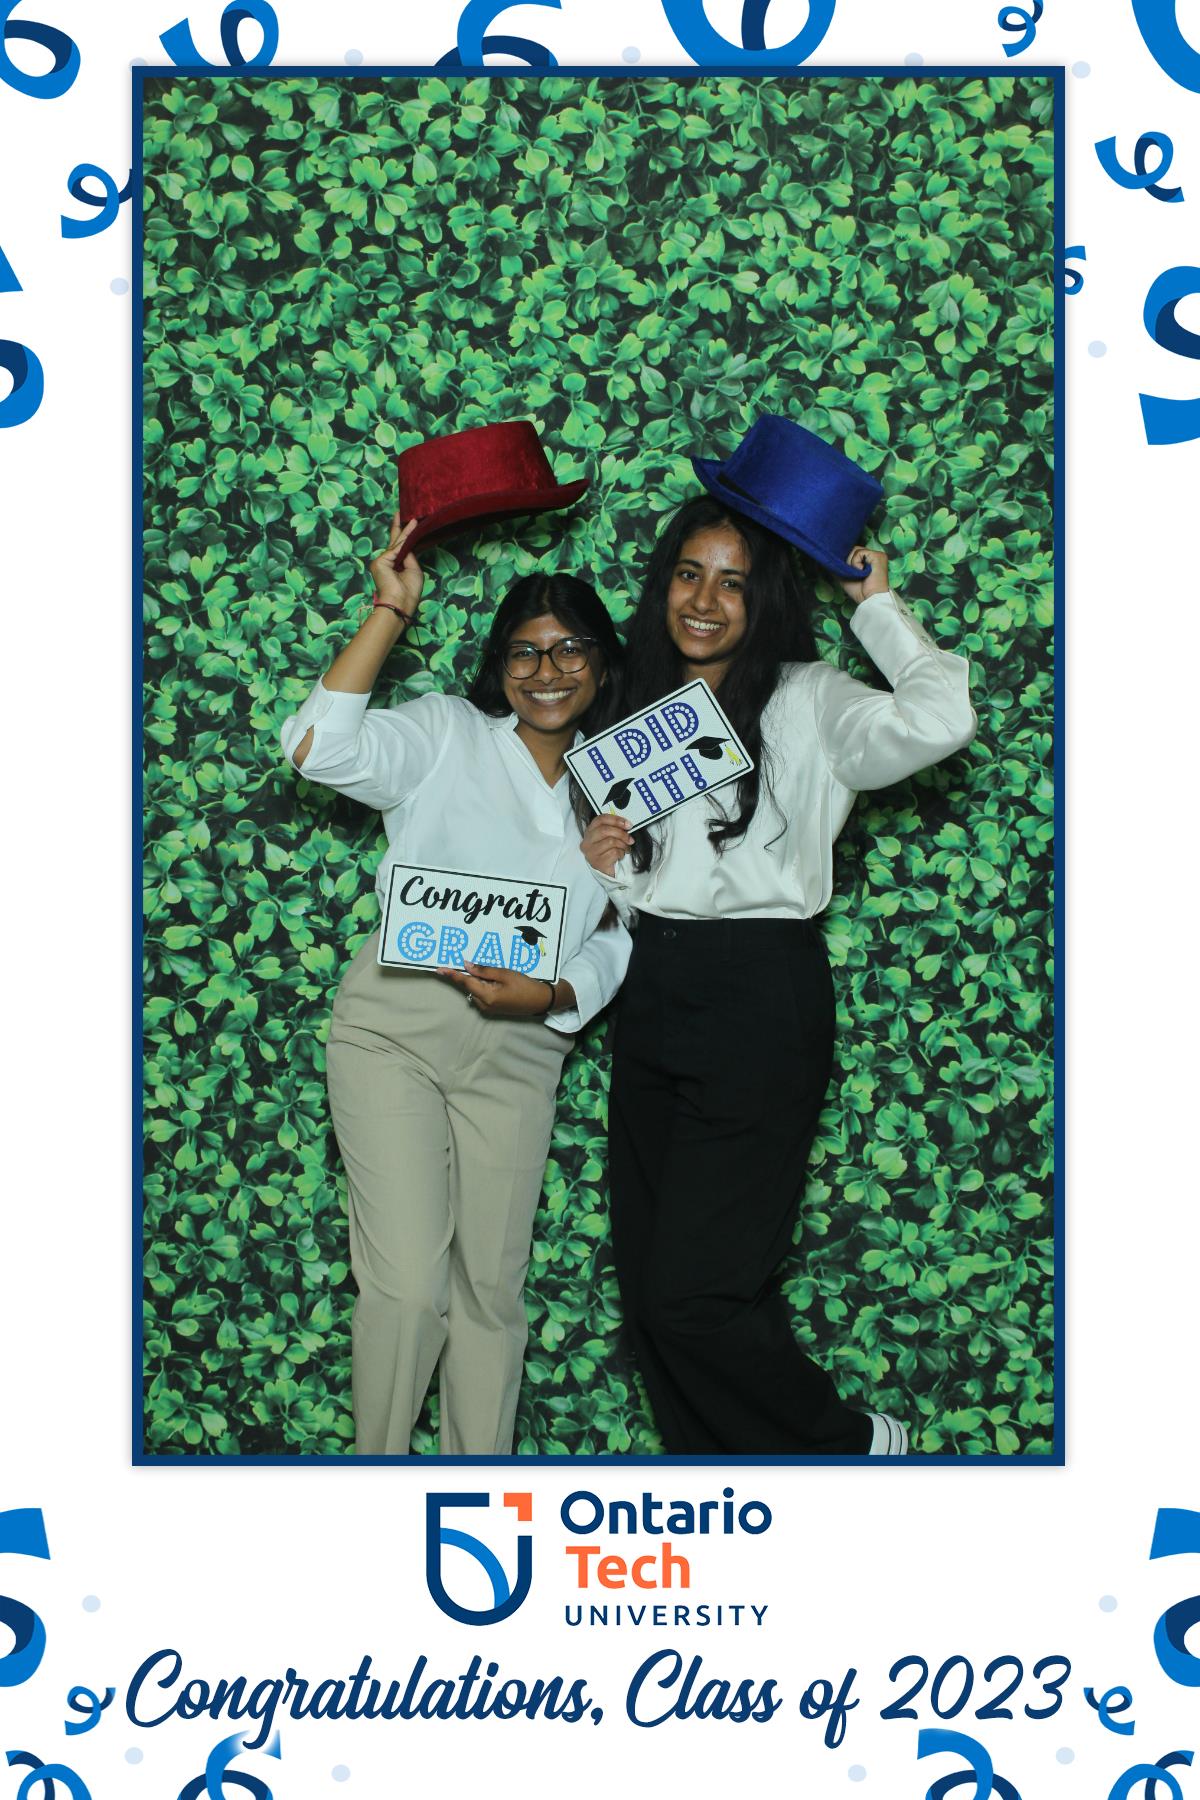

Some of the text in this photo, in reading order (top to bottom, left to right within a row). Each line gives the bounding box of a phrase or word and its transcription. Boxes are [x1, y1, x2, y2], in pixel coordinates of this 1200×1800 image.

[587, 702, 699, 783] I DID
[633, 753, 708, 815] IT!
[400, 875, 552, 924] Congrats
[397, 921, 540, 976] GRAD
